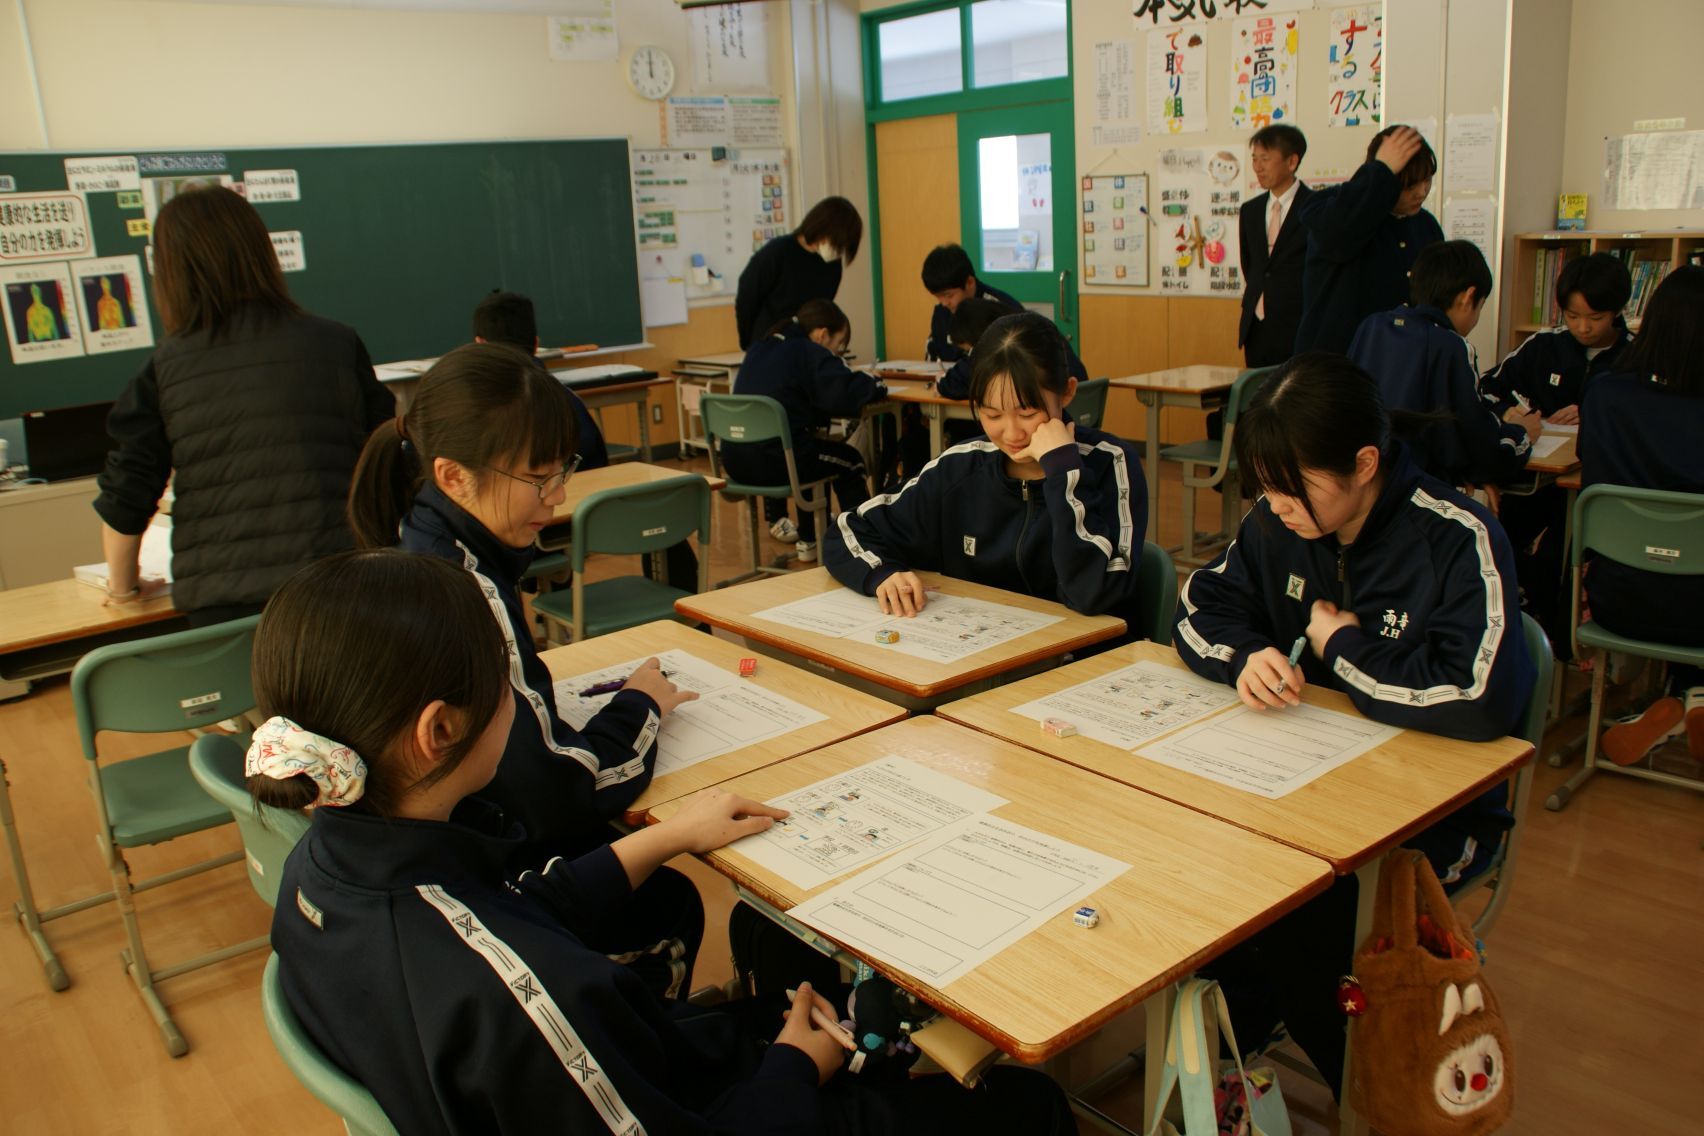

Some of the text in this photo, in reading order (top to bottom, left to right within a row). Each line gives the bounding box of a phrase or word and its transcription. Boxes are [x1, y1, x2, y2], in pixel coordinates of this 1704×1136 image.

[1163, 26, 1185, 134] で取り組む
[1329, 89, 1370, 116] クラス
[0, 227, 85, 254] 自分の力を発揮しよう
